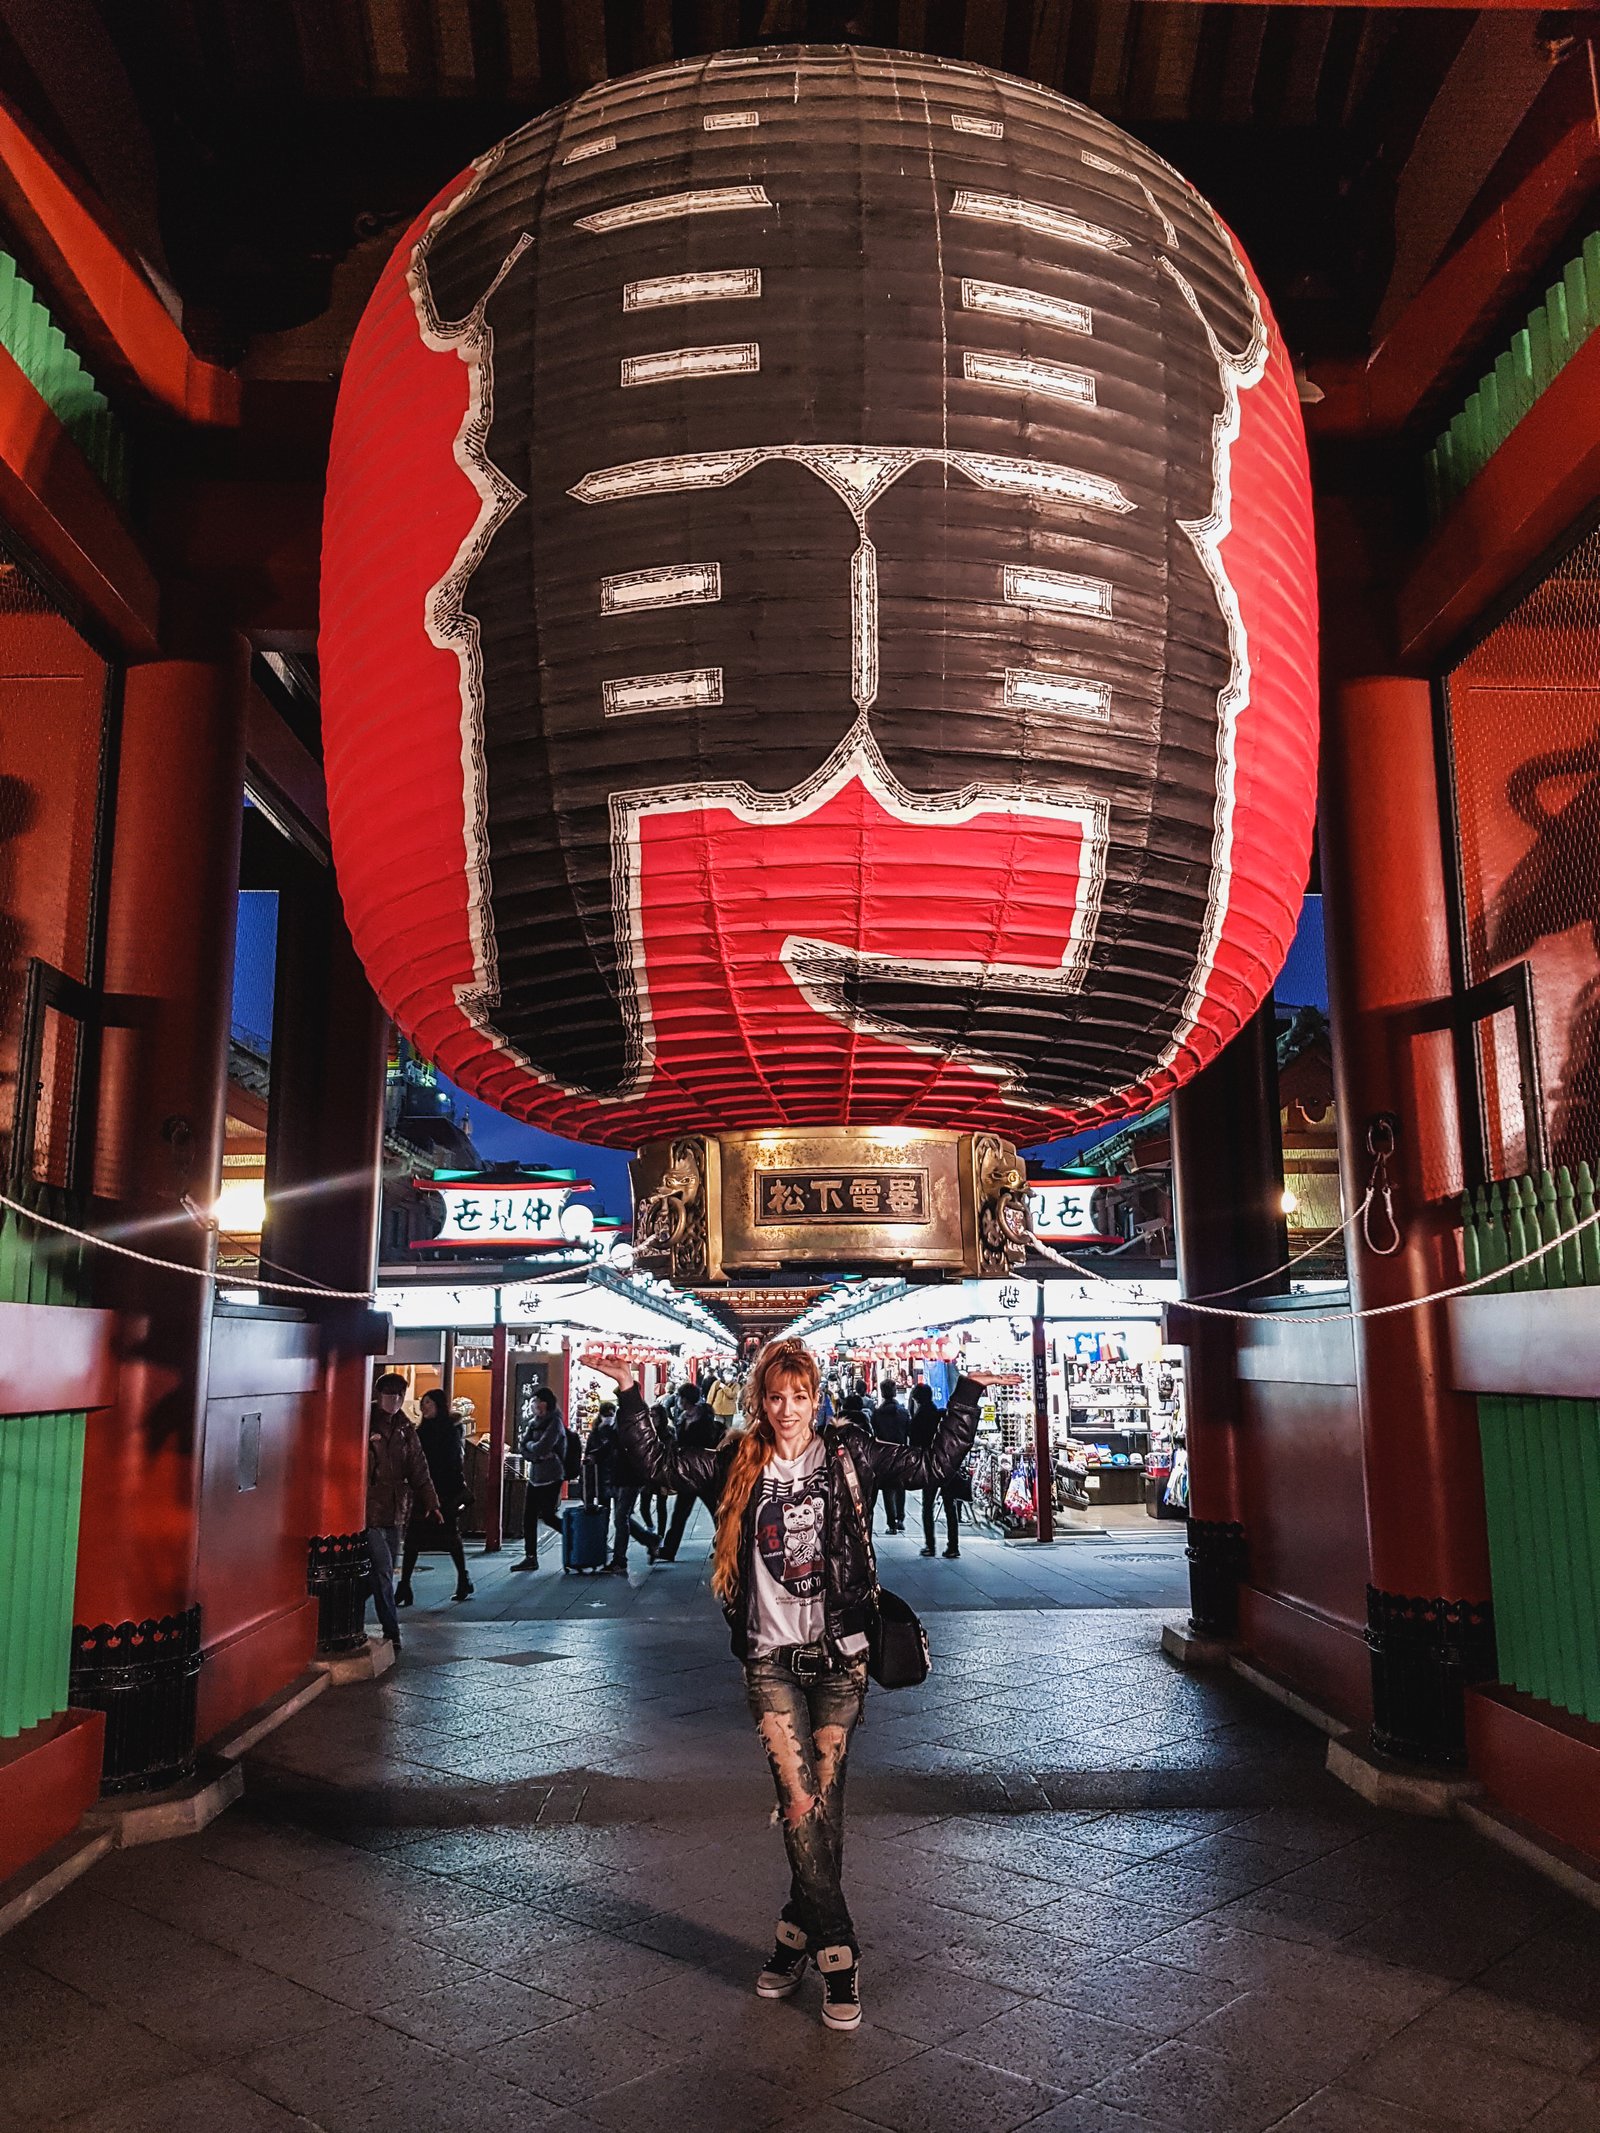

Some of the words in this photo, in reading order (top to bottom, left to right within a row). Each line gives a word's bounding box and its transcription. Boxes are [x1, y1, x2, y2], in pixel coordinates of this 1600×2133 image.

[767, 1178, 919, 1214] 松下電器
[794, 1576, 821, 1593] TOKY
